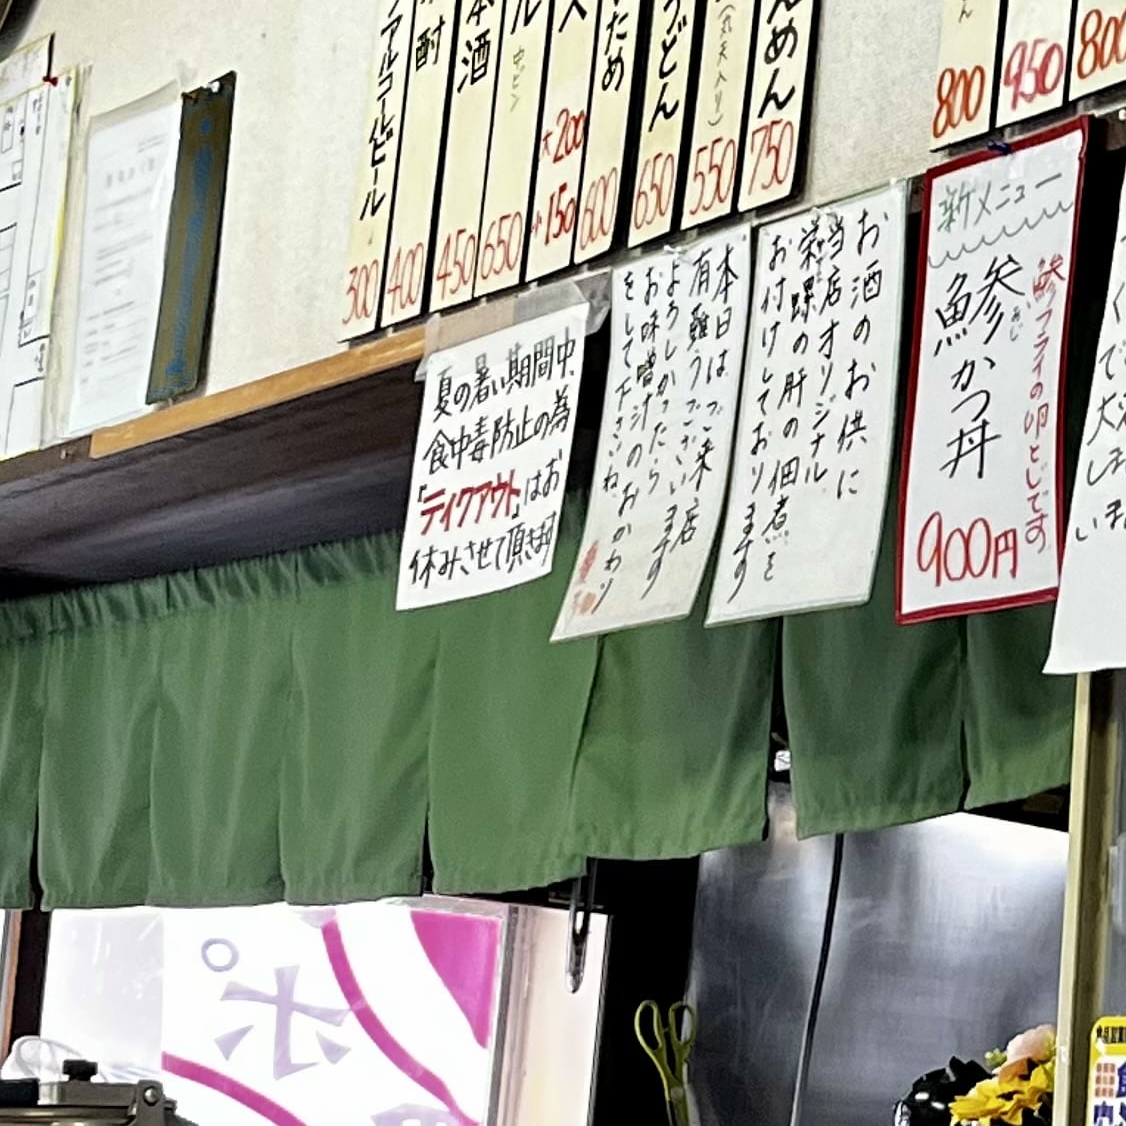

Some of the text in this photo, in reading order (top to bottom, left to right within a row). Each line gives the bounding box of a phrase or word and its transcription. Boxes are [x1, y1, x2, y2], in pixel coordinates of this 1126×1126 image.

[932, 64, 986, 139] 800
[1003, 37, 1065, 111] 950
[633, 151, 675, 230] 650
[689, 136, 736, 216] 550
[745, 118, 796, 199] 750
[579, 165, 618, 252] 600
[937, 173, 1063, 234] 新メニュー
[386, 240, 425, 317] 400
[436, 225, 478, 302] 450
[480, 209, 524, 284] 650
[342, 256, 379, 328] 300
[804, 212, 846, 484] 当店オリジナル
[835, 208, 889, 501] お酒のお供に
[917, 510, 1020, 588] 900円
